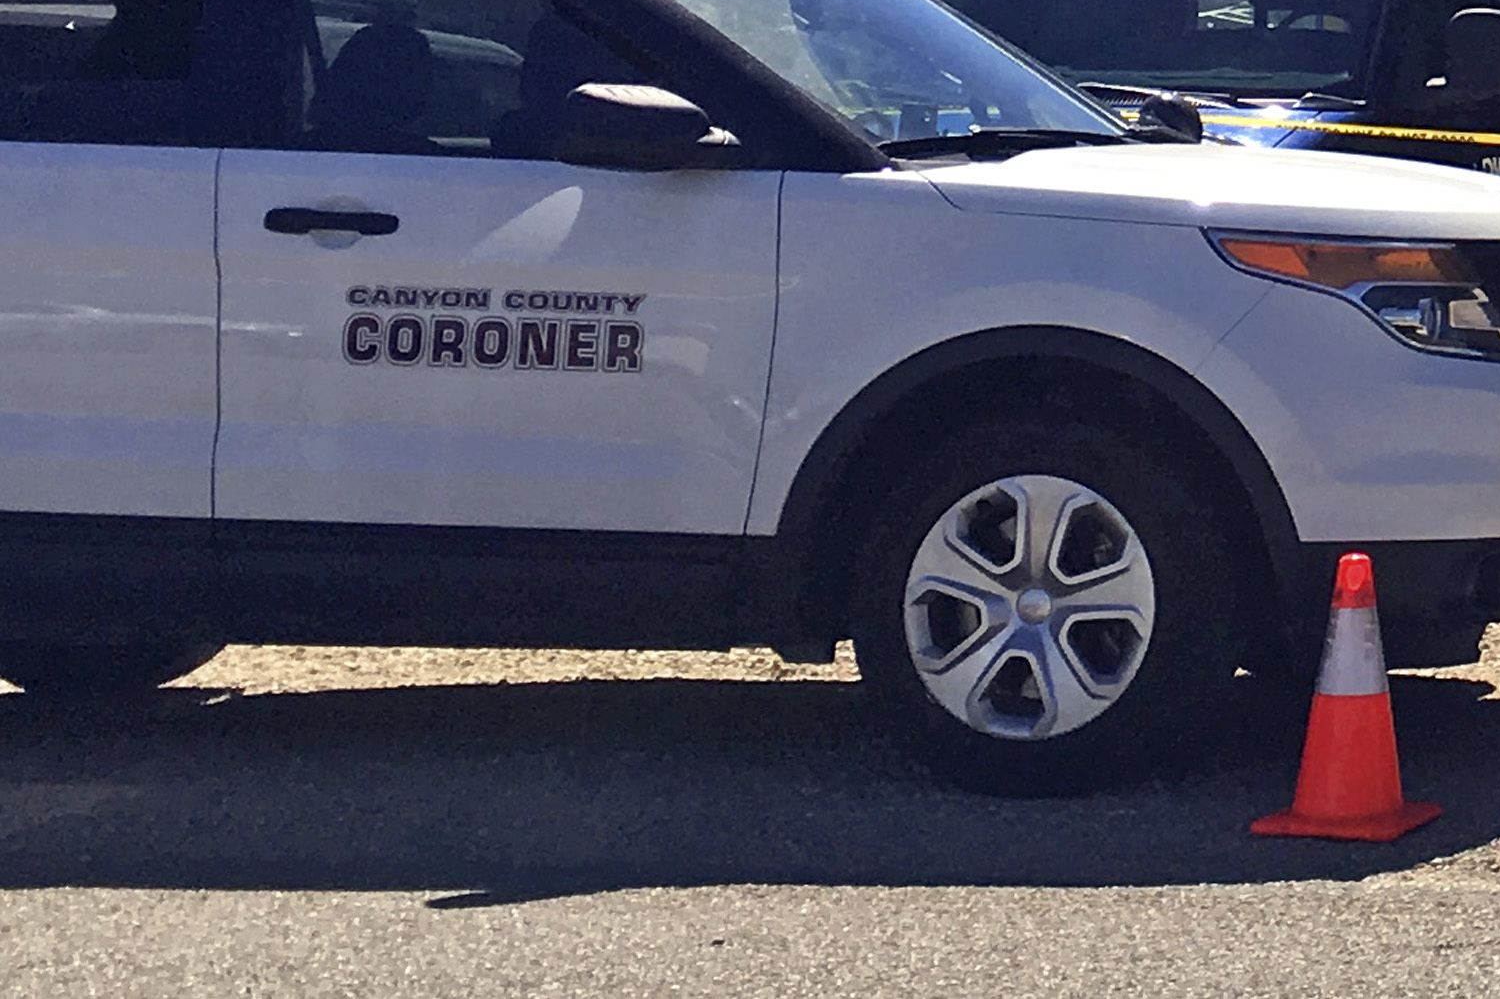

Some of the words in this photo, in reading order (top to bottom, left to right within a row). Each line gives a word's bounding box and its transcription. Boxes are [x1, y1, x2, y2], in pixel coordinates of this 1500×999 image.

[347, 286, 491, 310] CANYON
[502, 290, 648, 313] COUNTY
[342, 313, 645, 372] CORONER
